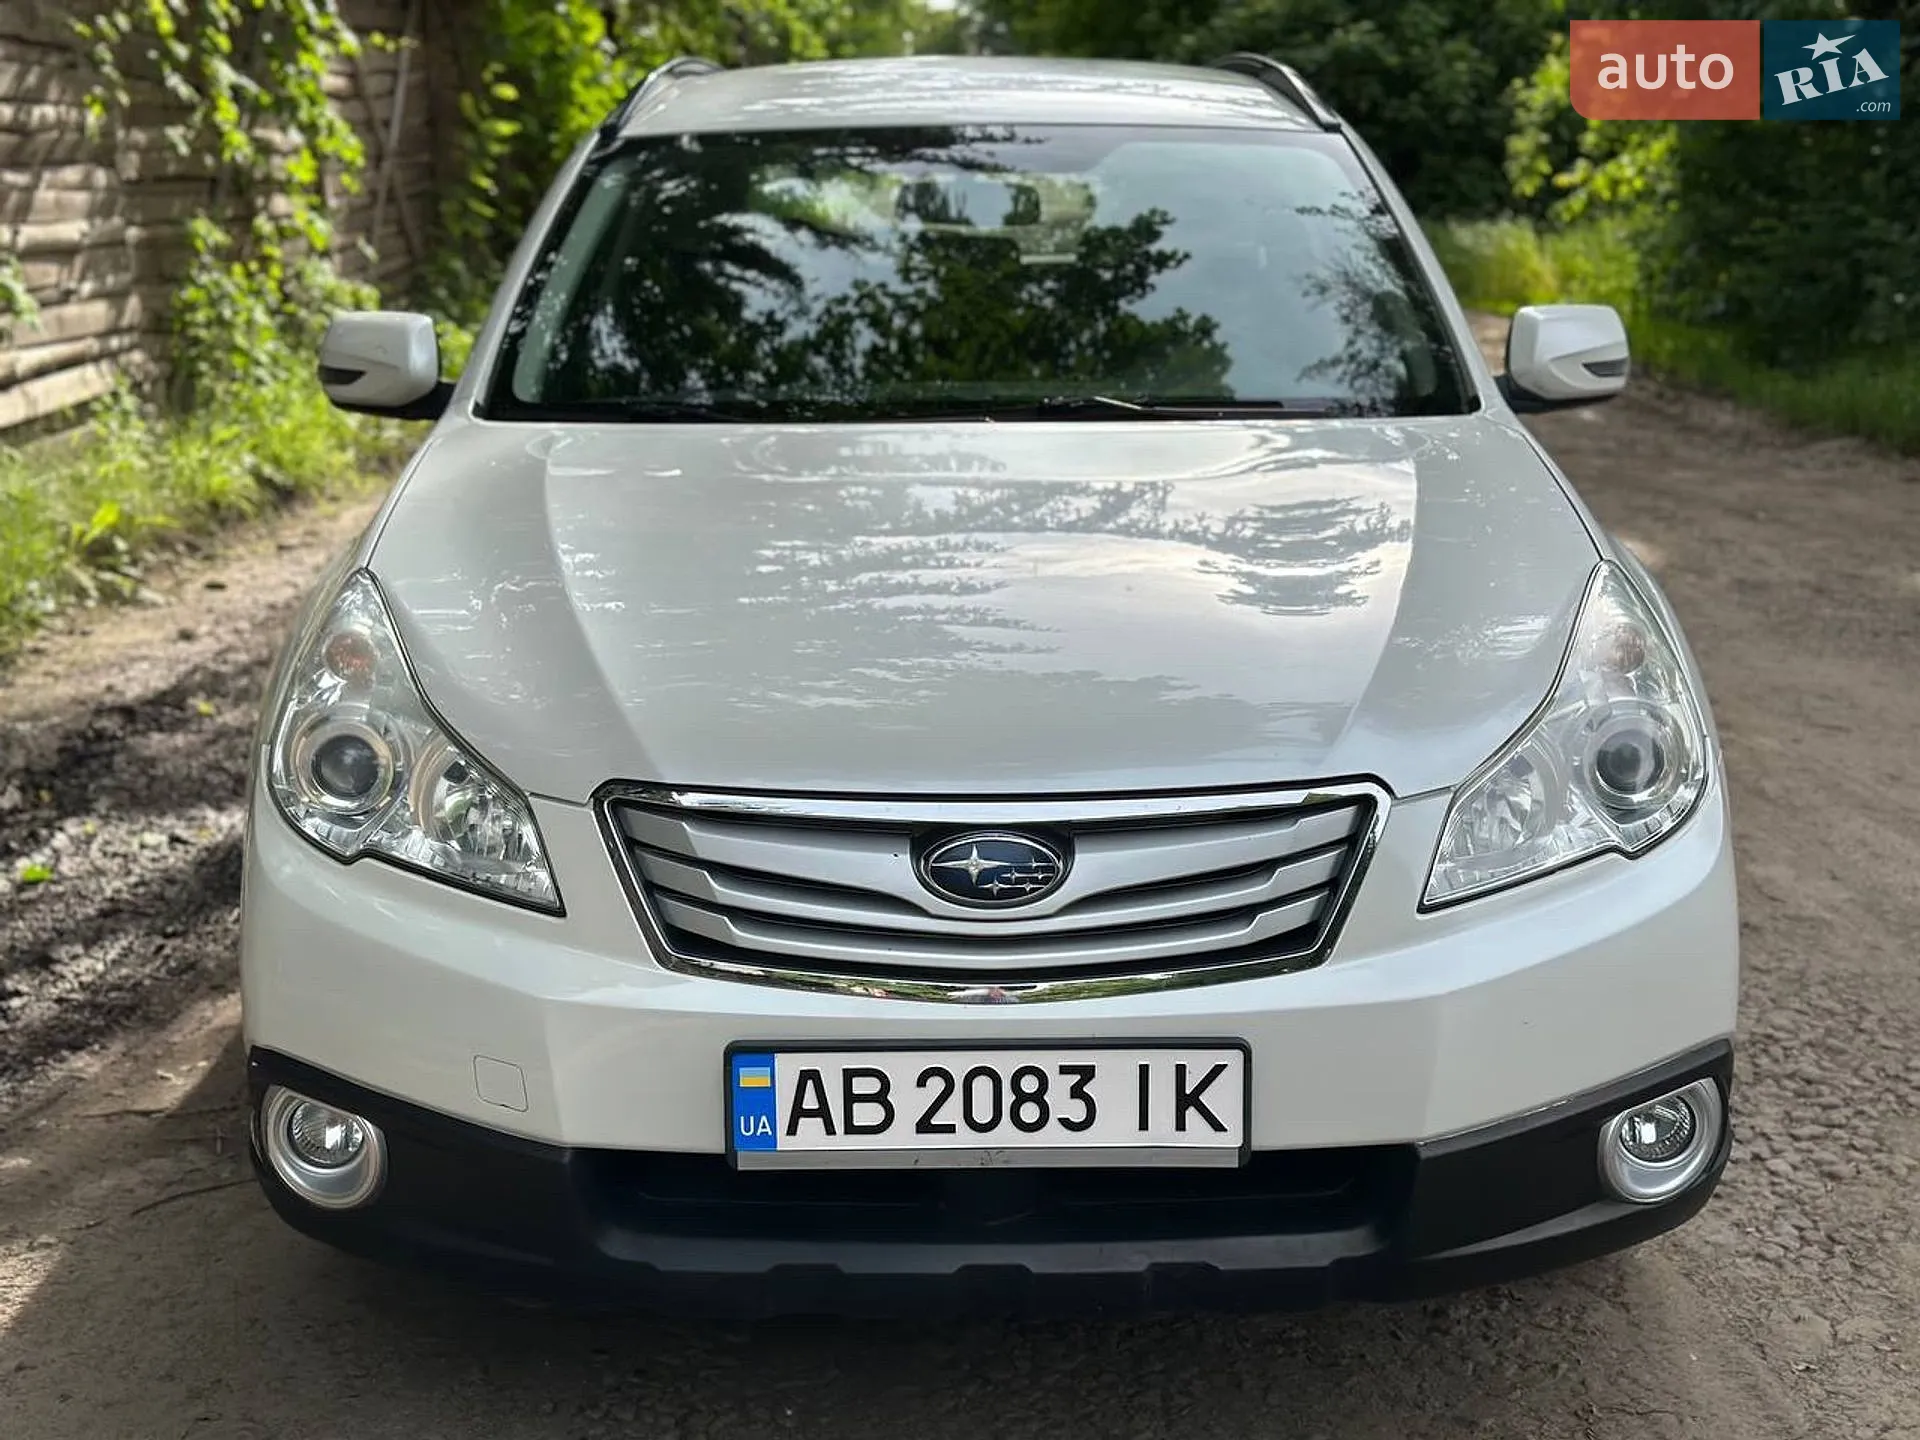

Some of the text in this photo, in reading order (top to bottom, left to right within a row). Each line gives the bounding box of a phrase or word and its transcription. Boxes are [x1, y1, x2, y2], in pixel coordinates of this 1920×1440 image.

[786, 1067, 896, 1136] AB
[915, 1064, 1098, 1134] 2083
[740, 1115, 773, 1137] UA
